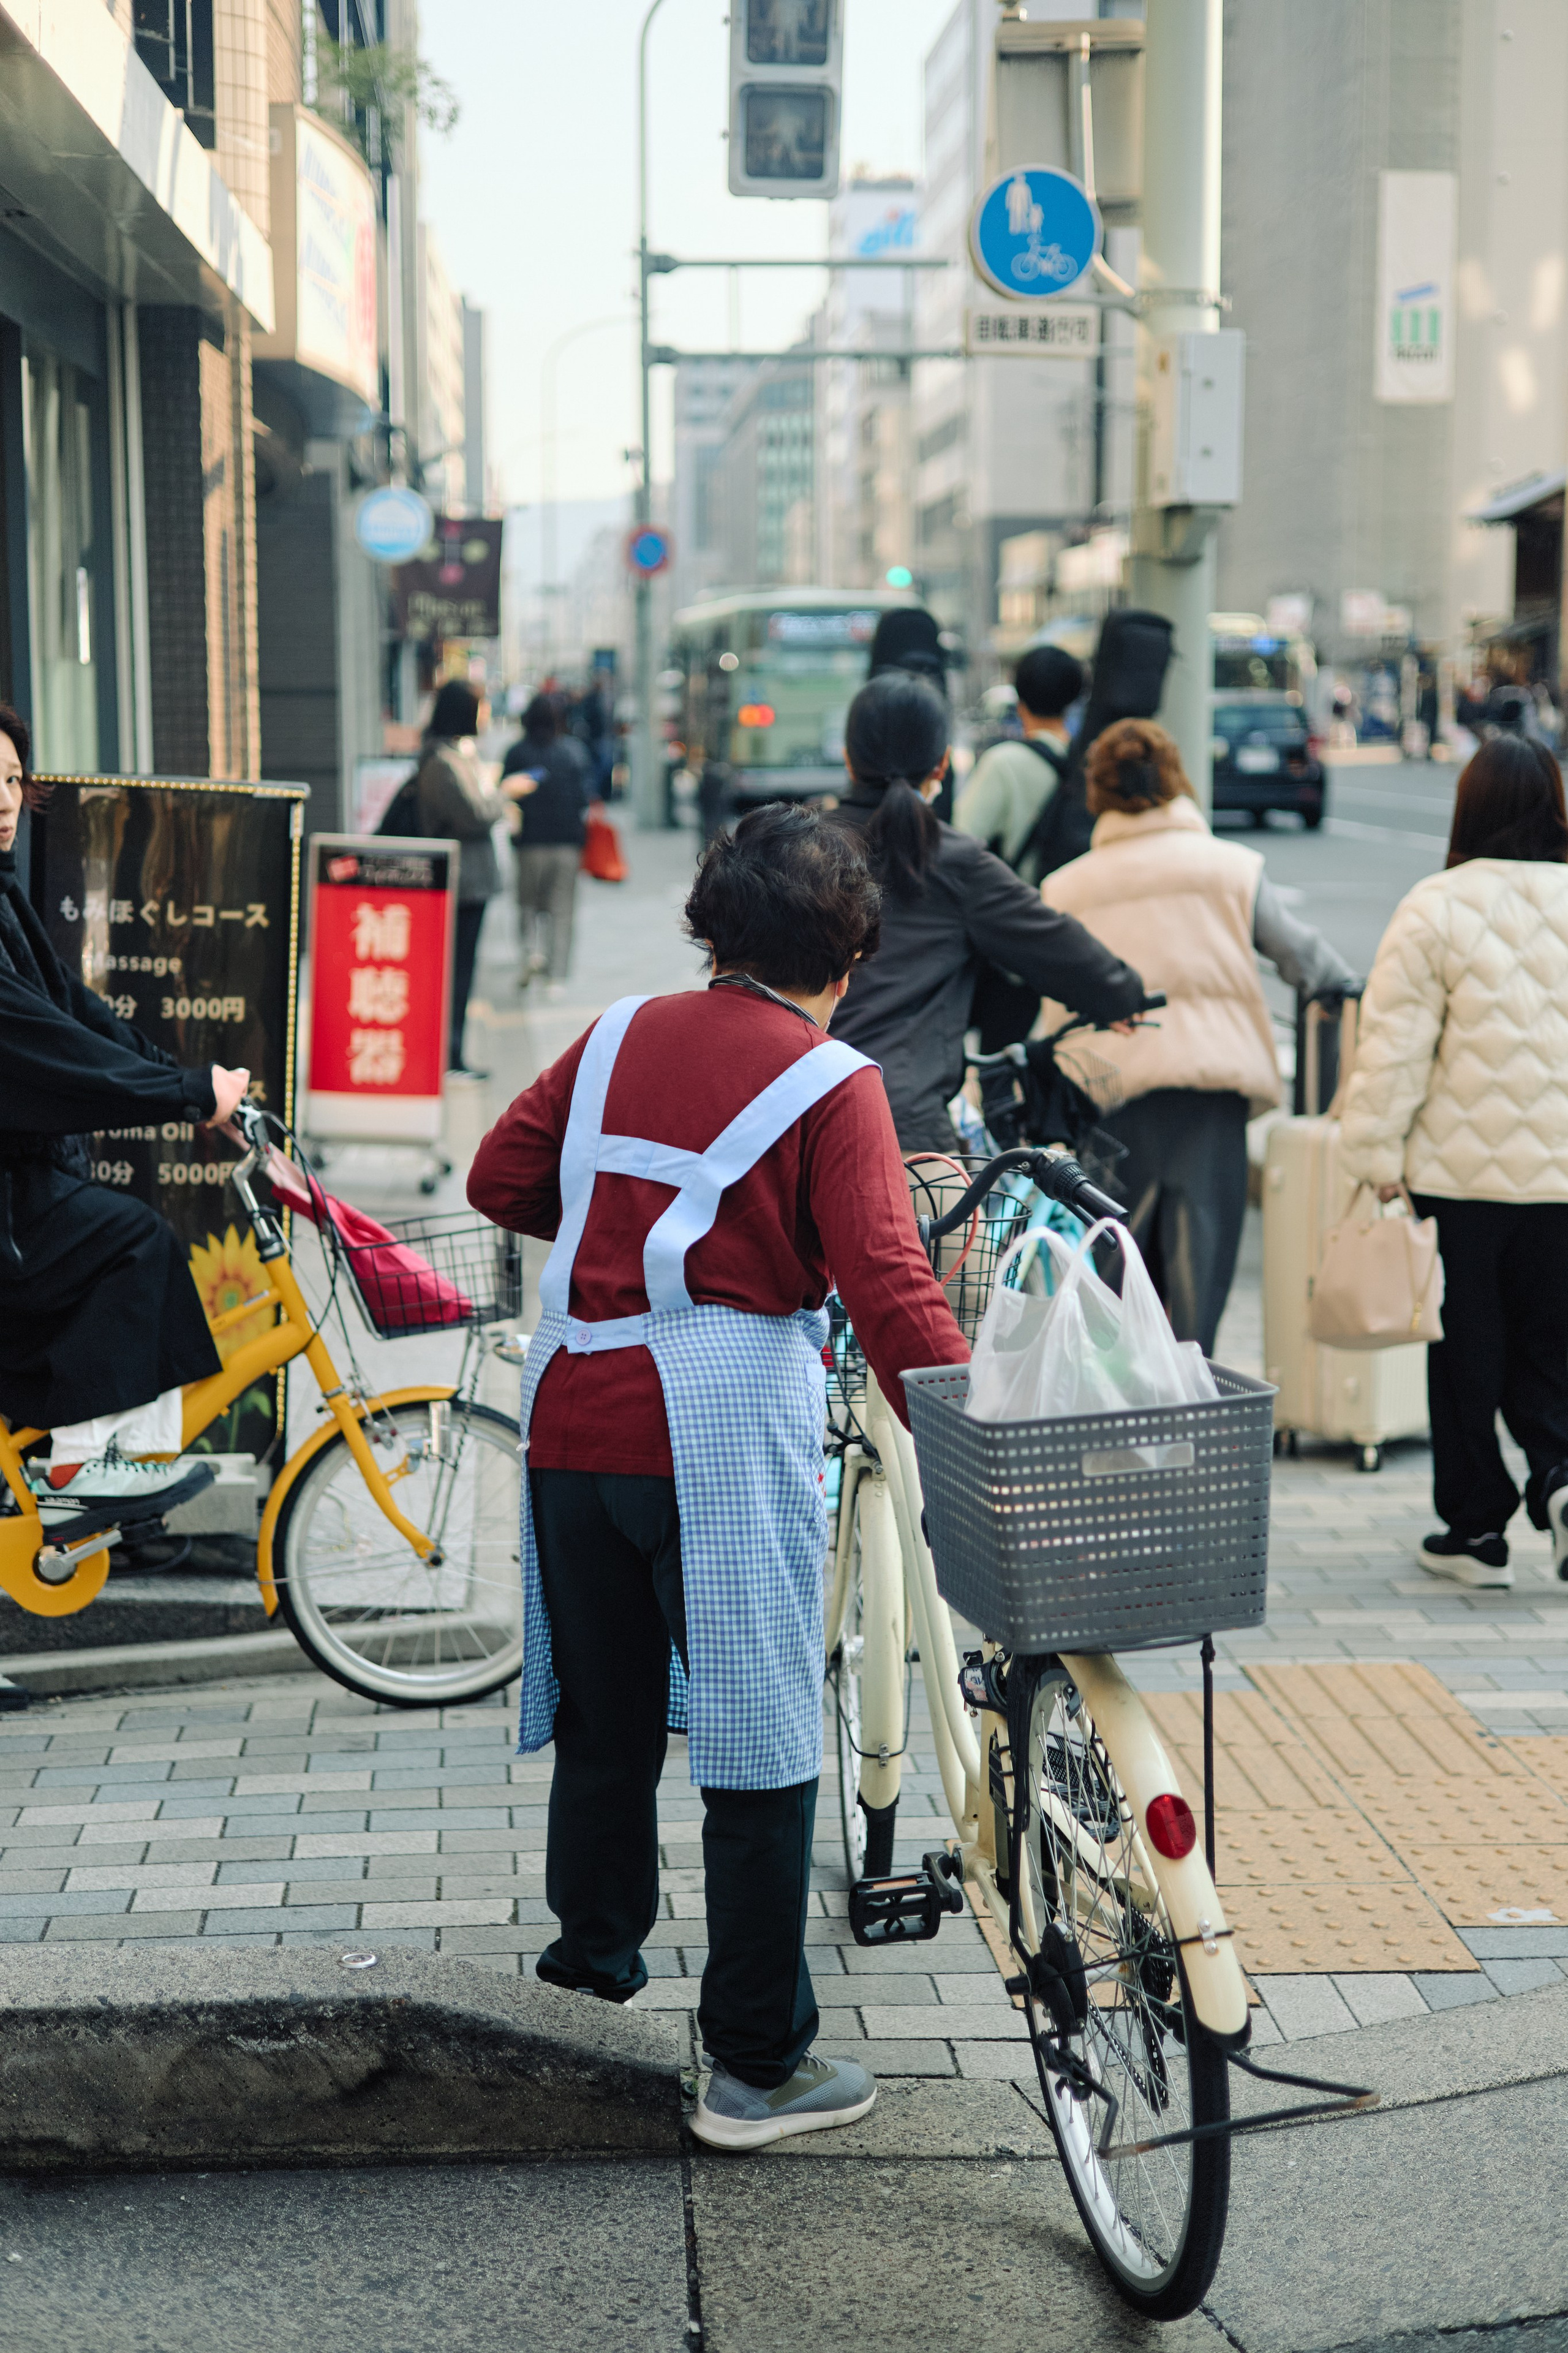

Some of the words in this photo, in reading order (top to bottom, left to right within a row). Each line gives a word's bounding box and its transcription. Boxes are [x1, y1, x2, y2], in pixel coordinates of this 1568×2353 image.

[59, 895, 271, 928] もみほぐしコース
[160, 996, 245, 1023] 3000円
[161, 1121, 194, 1142] Oil
